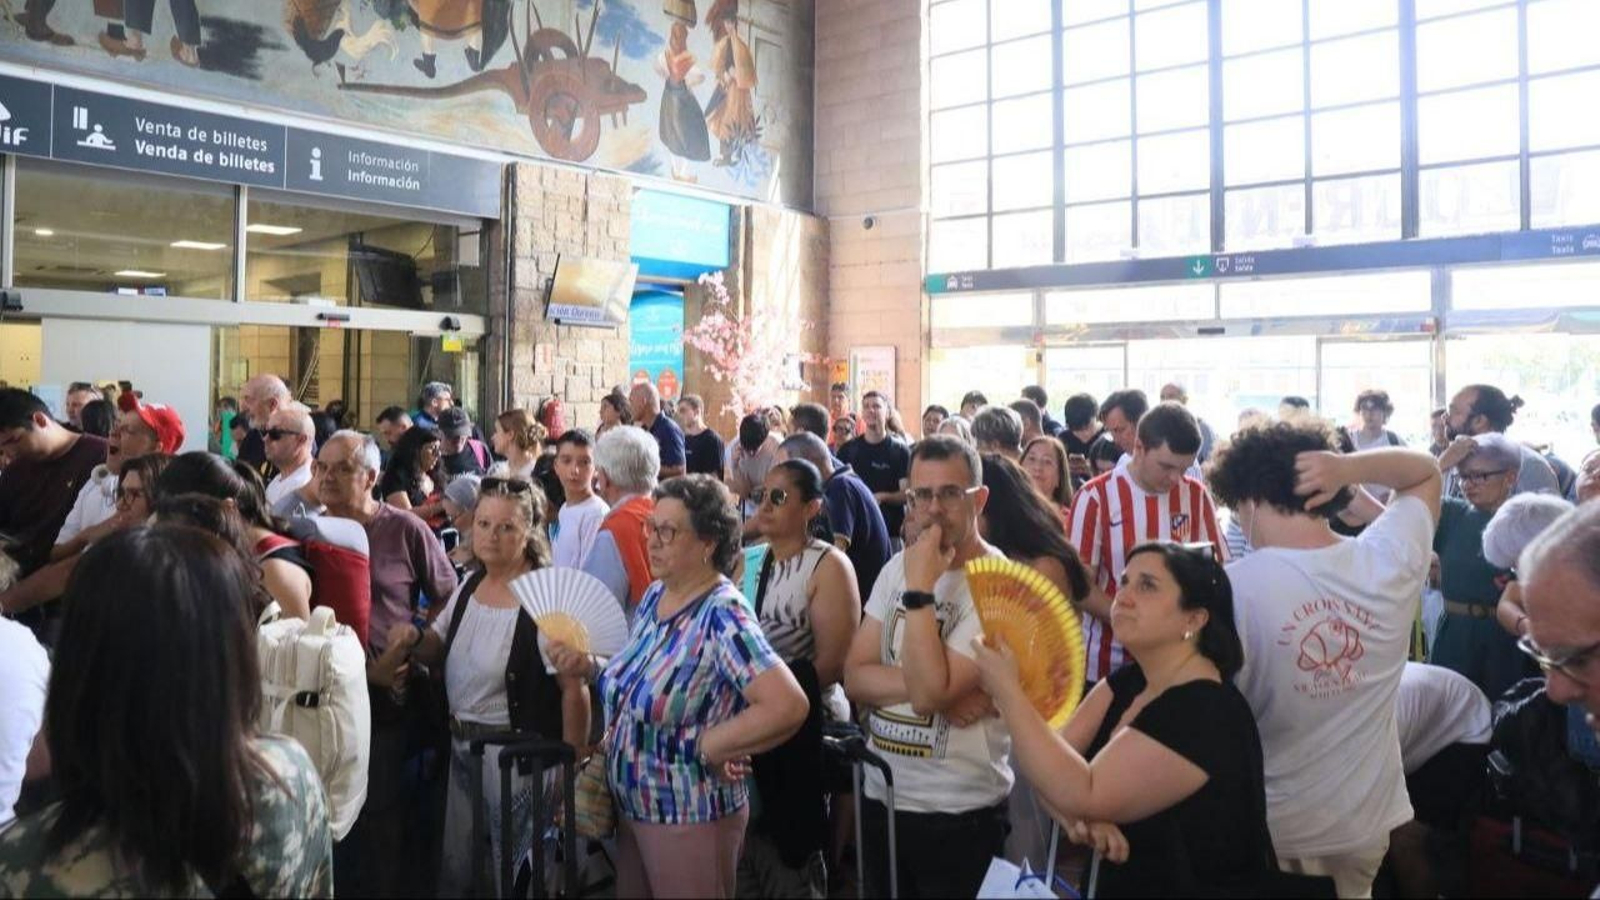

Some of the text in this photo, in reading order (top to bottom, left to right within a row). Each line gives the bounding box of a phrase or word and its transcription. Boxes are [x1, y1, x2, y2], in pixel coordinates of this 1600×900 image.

[135, 116, 267, 152] Venta de billetes
[135, 139, 275, 173] Venda de billetes
[348, 150, 419, 172] Información
[348, 170, 420, 190] Información
